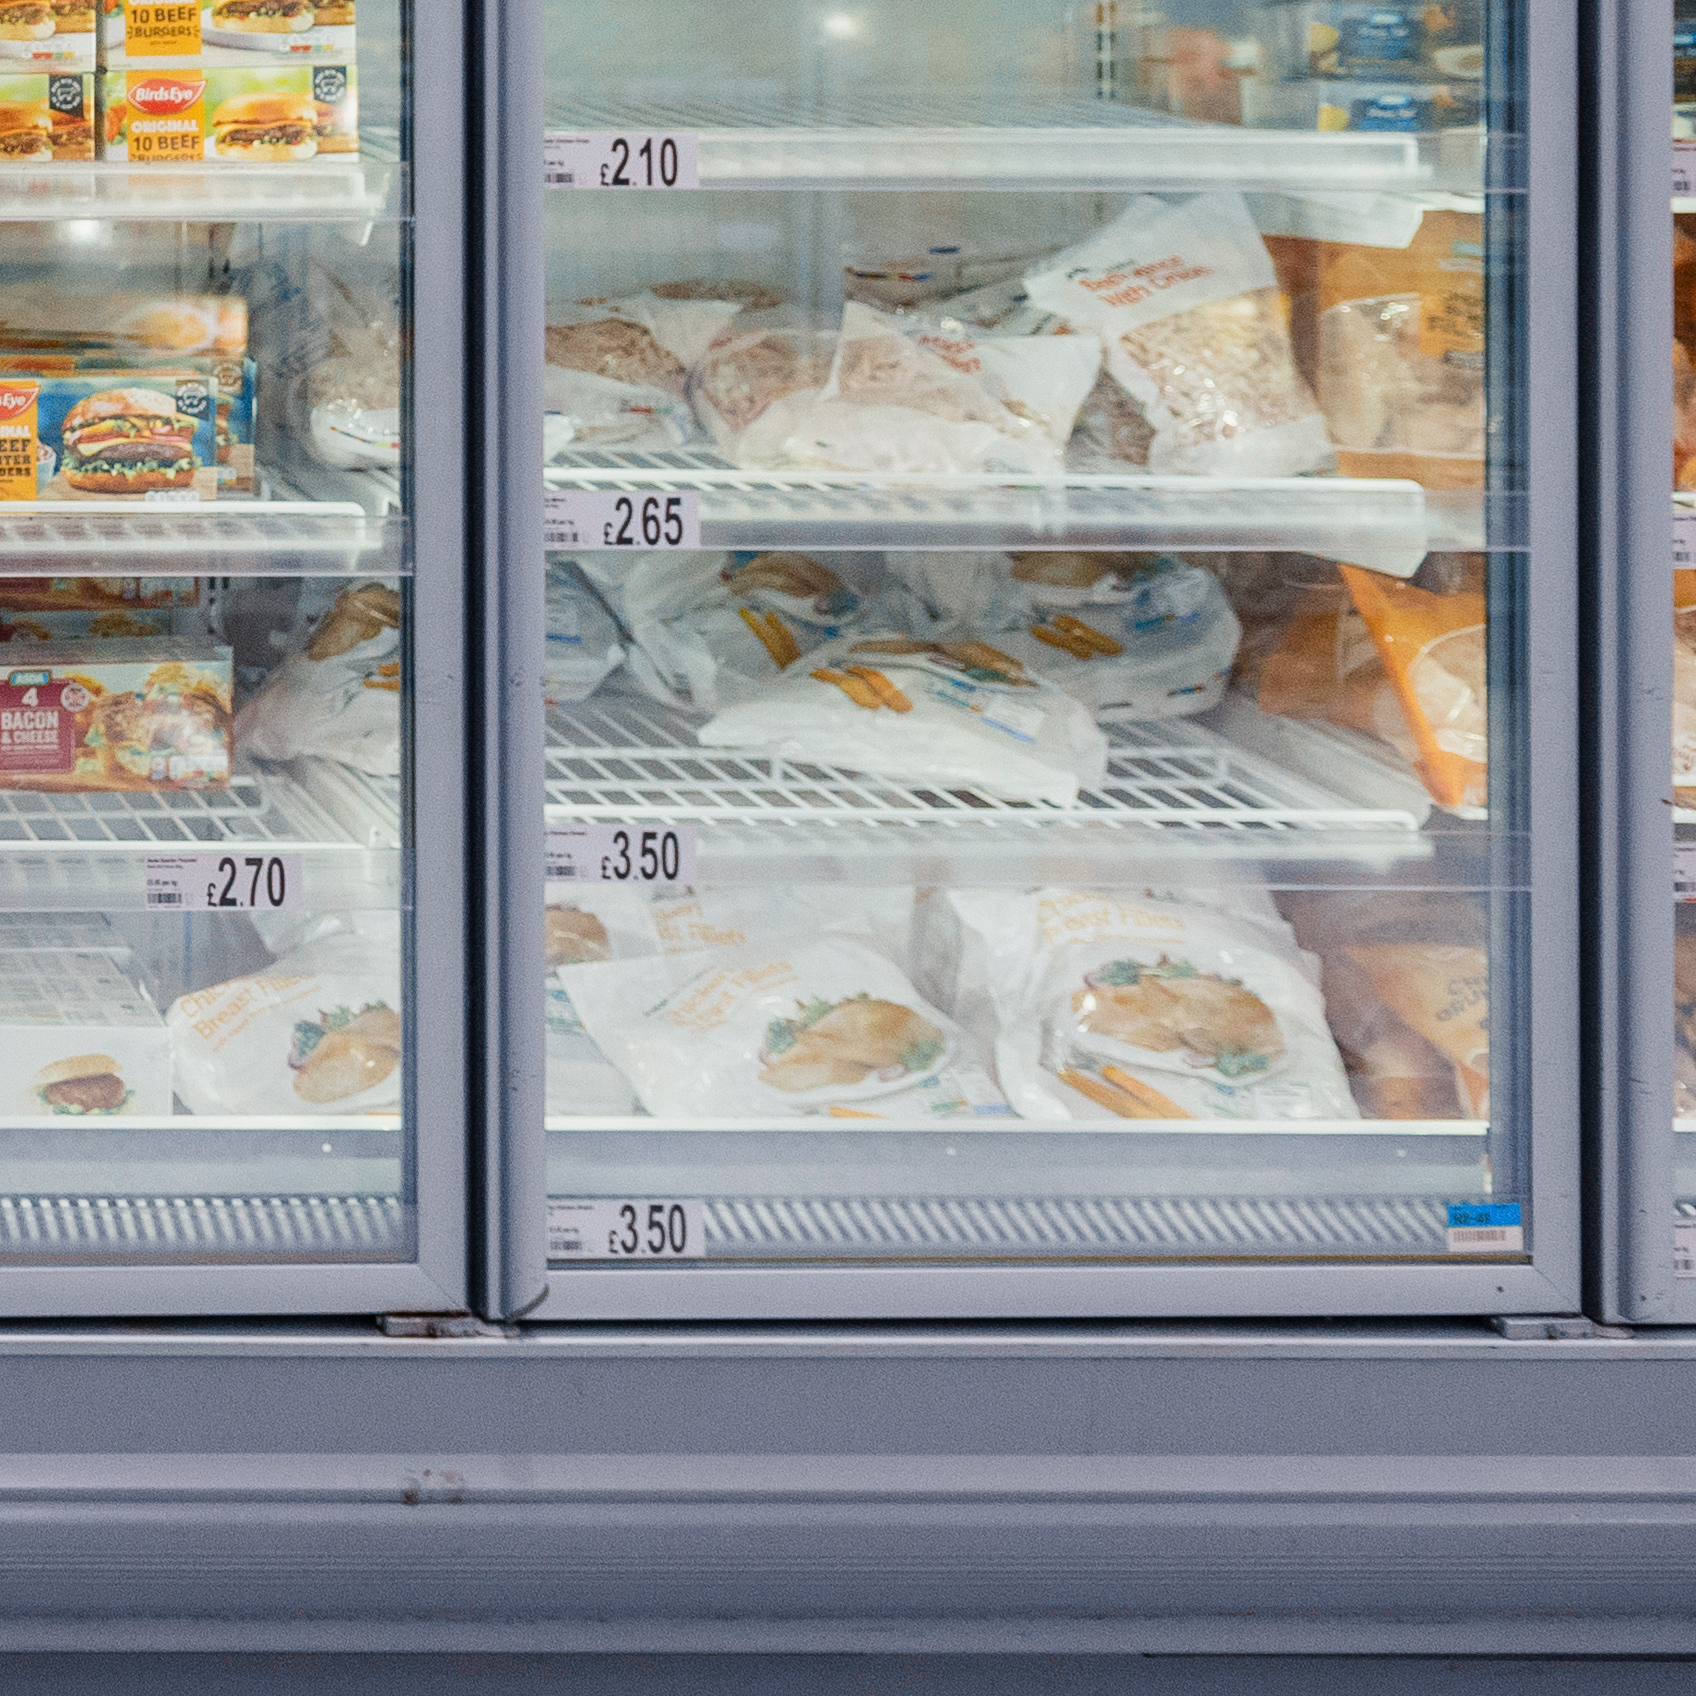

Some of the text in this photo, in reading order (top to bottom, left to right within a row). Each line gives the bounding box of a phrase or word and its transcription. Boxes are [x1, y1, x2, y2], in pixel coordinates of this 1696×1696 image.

[131, 5, 197, 24] 10 BEEF
[131, 24, 194, 39] BURGERS
[130, 120, 200, 134] ORIGINAL
[133, 135, 201, 152] 10 BEEF
[600, 138, 679, 187] £2.10
[603, 496, 684, 546] £2.65
[21, 687, 39, 707] 4
[0, 710, 60, 731] BACON
[0, 730, 60, 746] & CHEESE
[601, 831, 680, 881] £3.50
[206, 856, 287, 907] £2.70
[609, 1204, 688, 1254] £3.50
